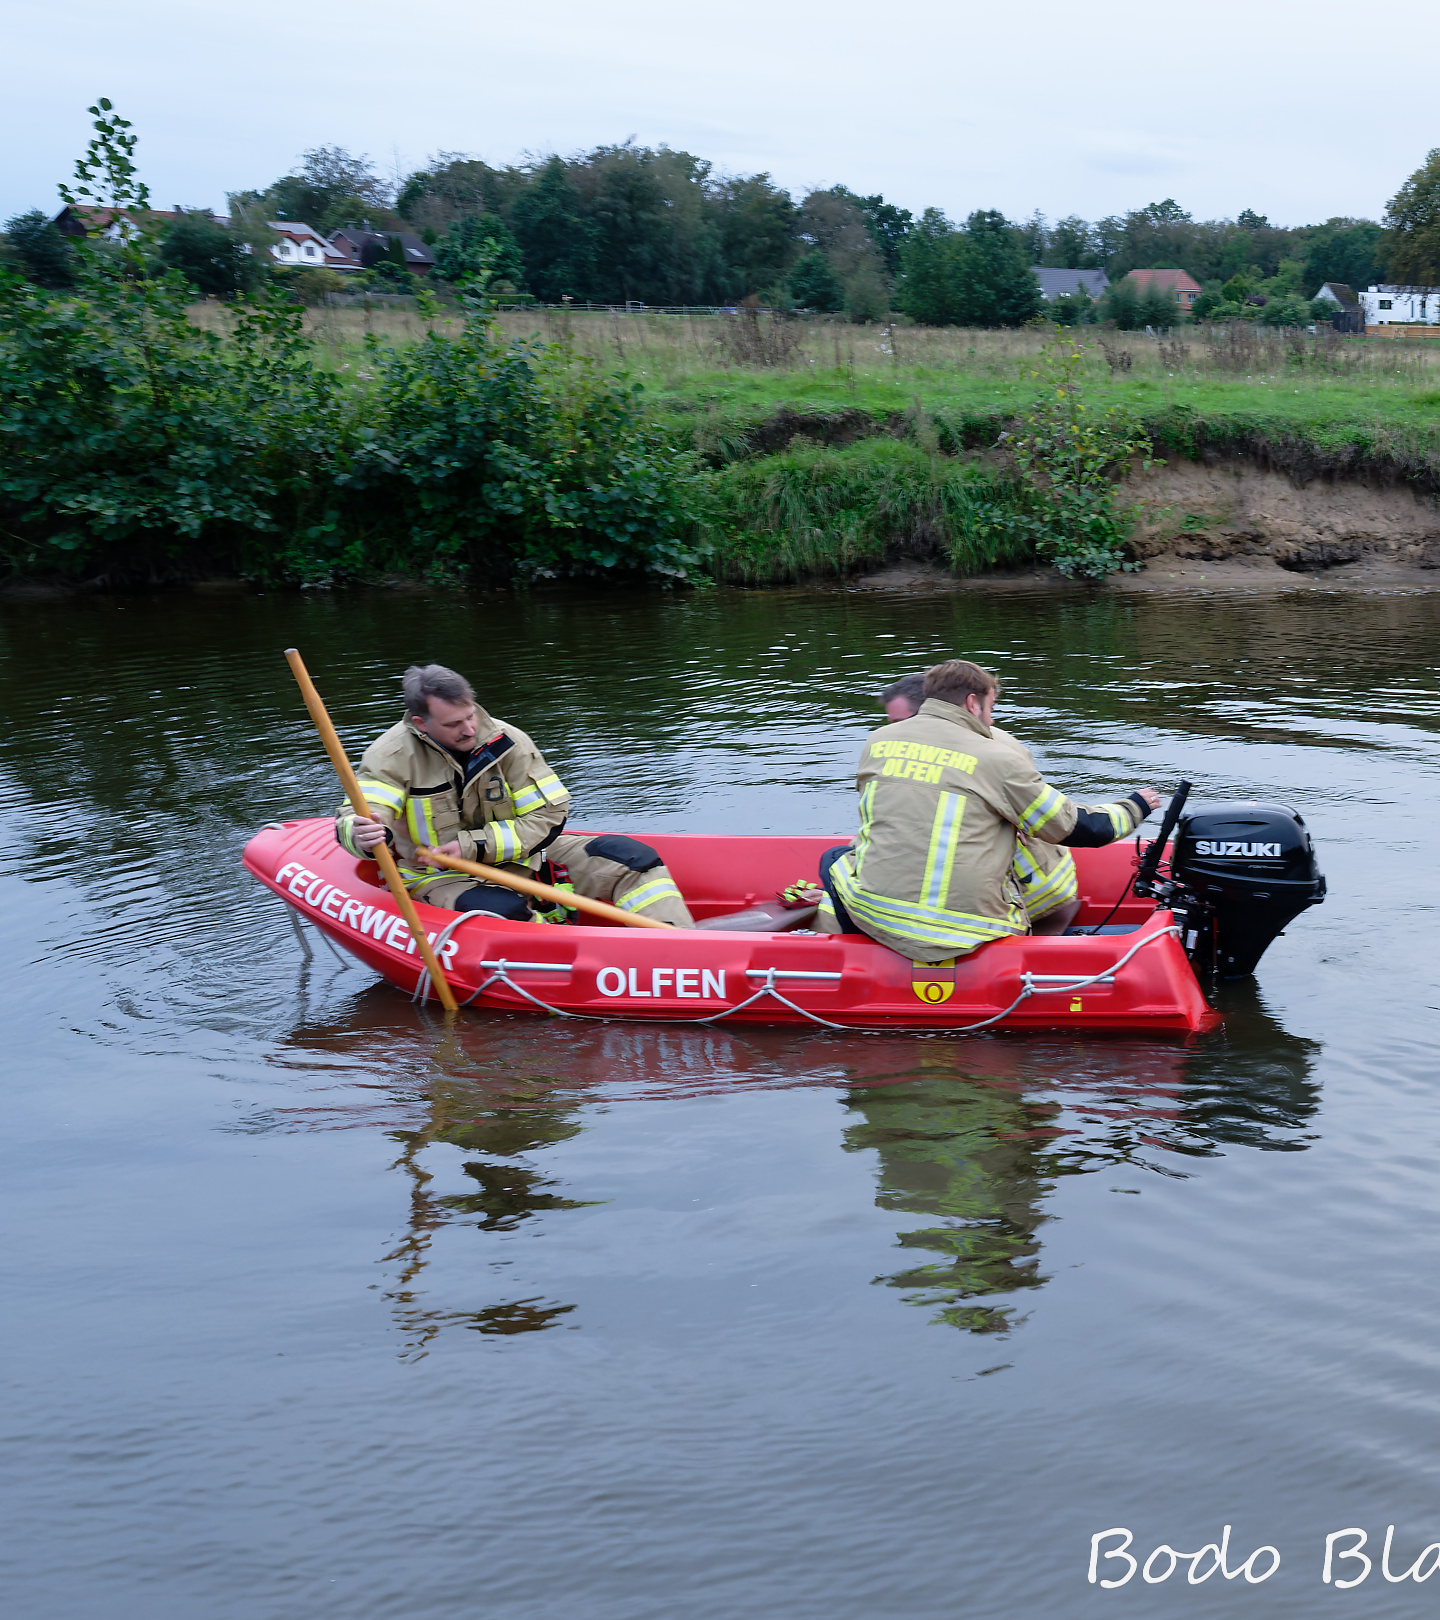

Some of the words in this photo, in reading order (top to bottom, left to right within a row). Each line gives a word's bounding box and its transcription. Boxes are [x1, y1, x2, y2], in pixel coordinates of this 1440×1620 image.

[869, 740, 978, 775] FEUERWEHR
[882, 758, 944, 784] OLFEN
[1195, 840, 1282, 857] SUZUKI
[597, 966, 726, 999] OLFEN
